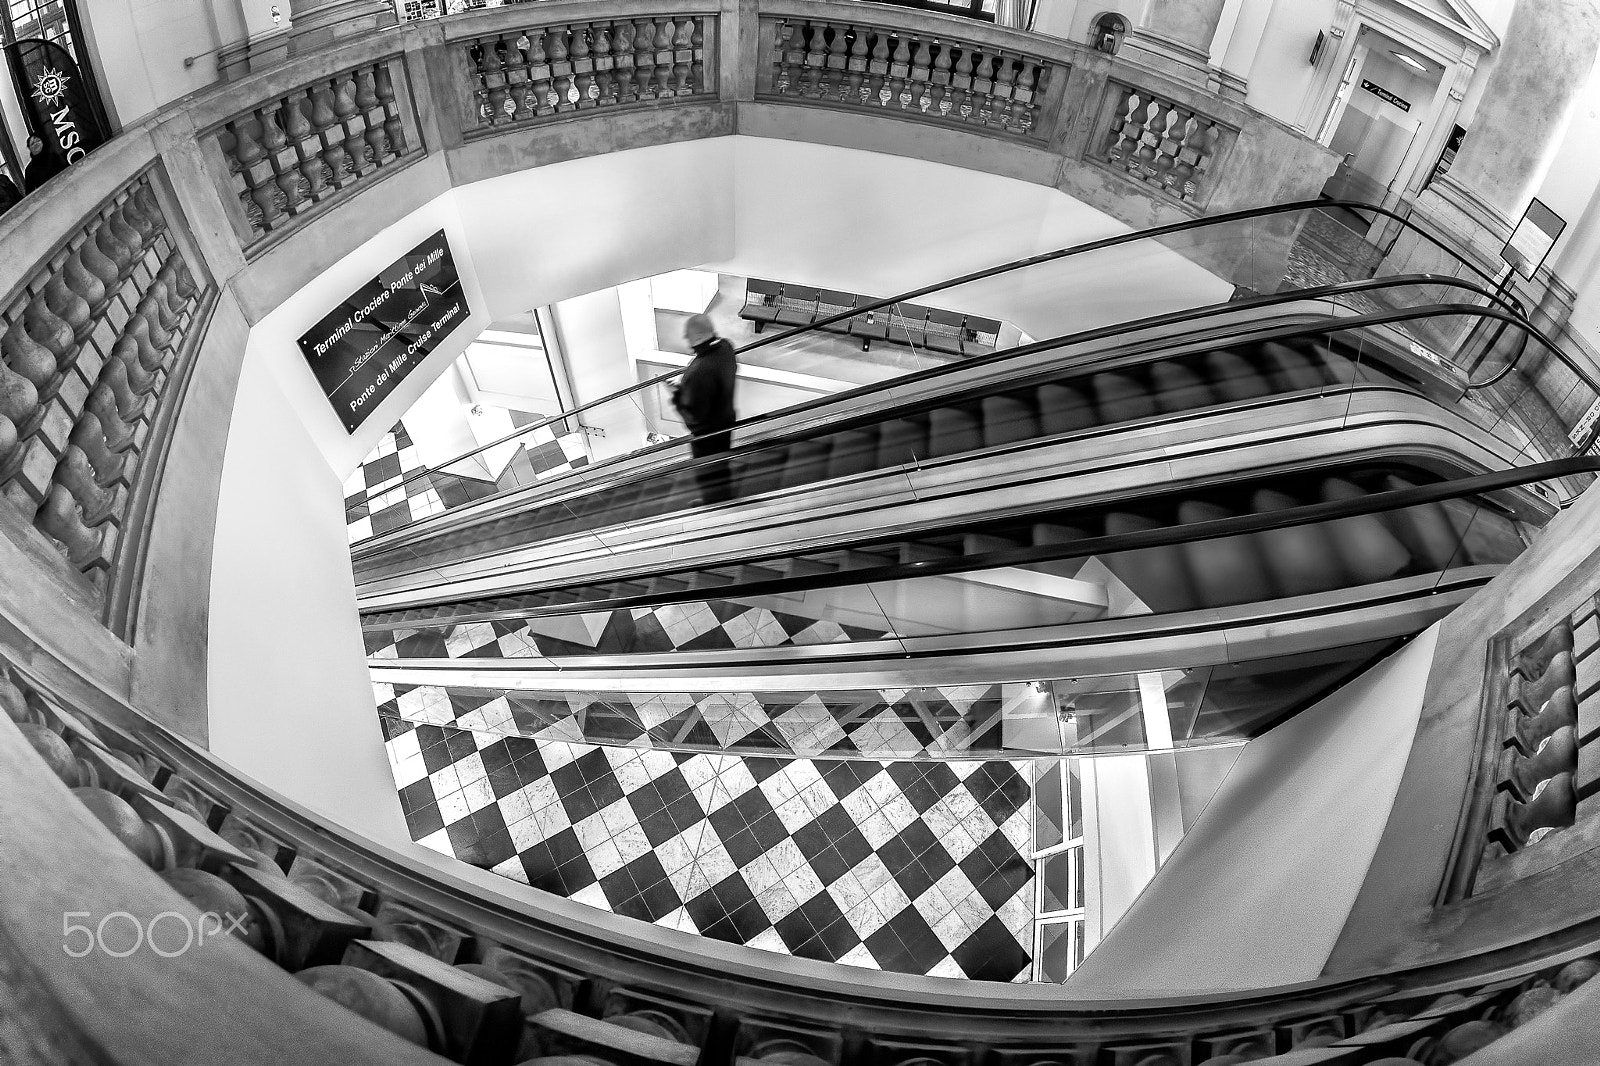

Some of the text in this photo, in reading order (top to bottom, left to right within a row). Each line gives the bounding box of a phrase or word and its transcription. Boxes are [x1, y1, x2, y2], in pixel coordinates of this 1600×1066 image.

[313, 247, 444, 357] Terminal Crociere Ponte dei Mille
[349, 302, 461, 412] Ponte dei Mille Cruise Terminal
